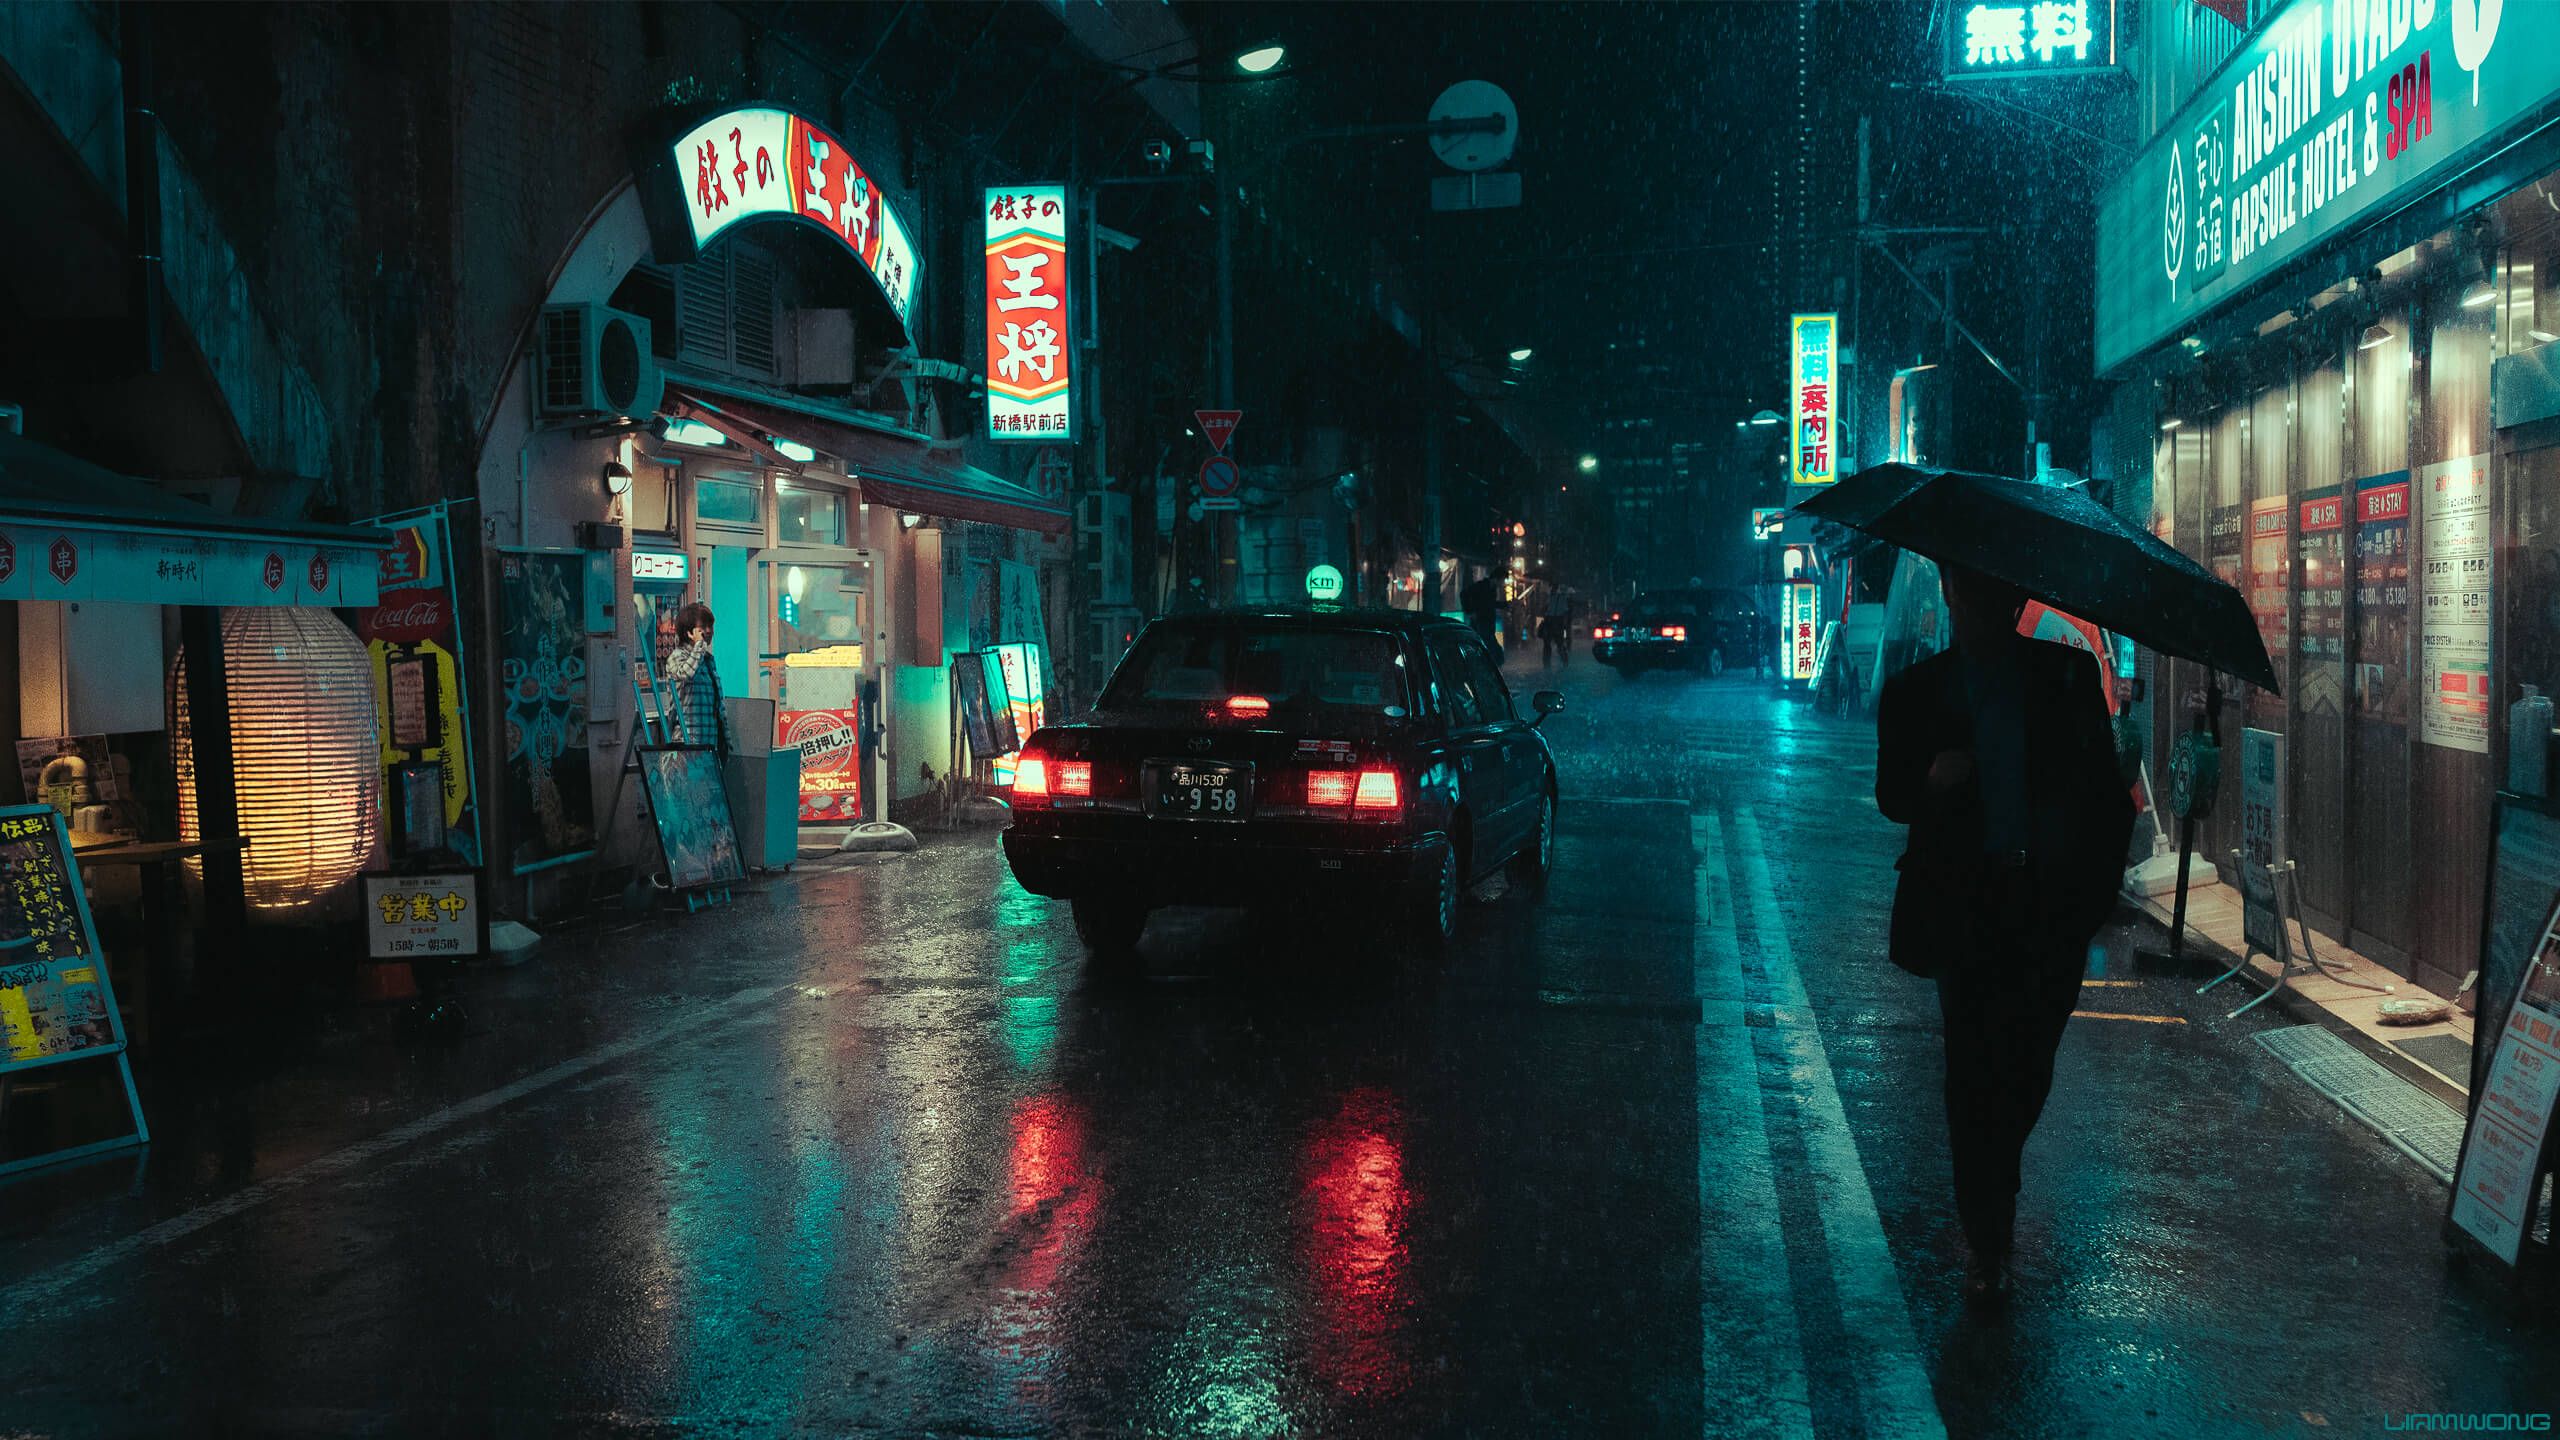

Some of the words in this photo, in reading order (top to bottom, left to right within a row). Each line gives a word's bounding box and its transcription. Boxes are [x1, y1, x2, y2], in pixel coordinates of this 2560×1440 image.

[1966, 0, 2092, 65] 無料
[2232, 3, 2324, 182] ANSHIN
[2231, 153, 2296, 266] CAPSULE
[2302, 107, 2357, 219] HOTEL
[2363, 91, 2379, 177] &
[2386, 49, 2432, 160] SPA
[697, 127, 775, 219] 餃子の
[805, 130, 871, 255] 王将
[989, 194, 1061, 221] 餃子の
[995, 252, 1061, 384] 王将
[1801, 321, 1829, 473] 無料案内所
[992, 413, 1067, 433] 新橋駅前店
[1205, 416, 1233, 428] 止まれ
[2386, 491, 2402, 512] STAY
[55, 549, 73, 577] 串
[157, 559, 198, 582] 新時代
[266, 561, 282, 585] 伝
[312, 563, 327, 587] 串
[372, 601, 440, 631] Coca-Cola
[378, 891, 467, 923] 営業中
